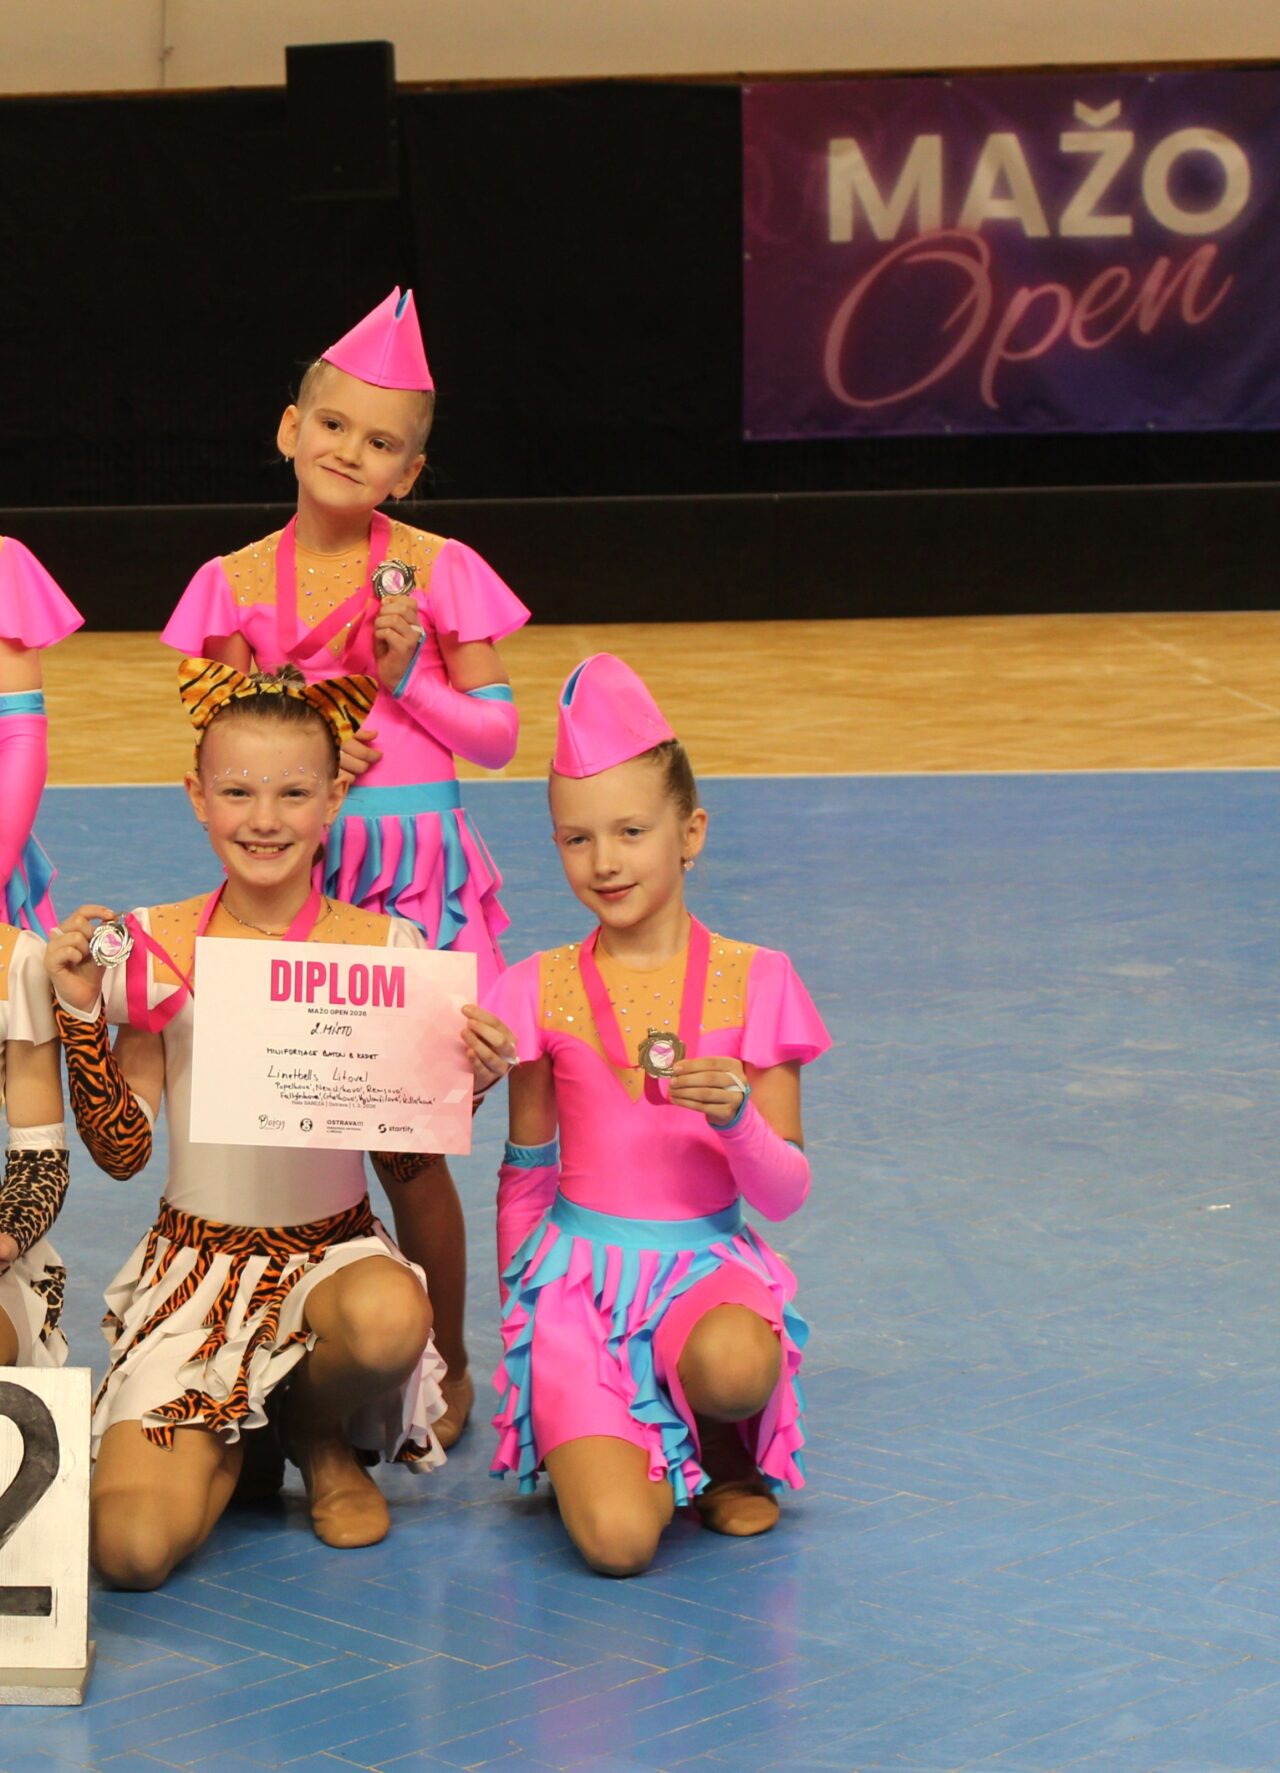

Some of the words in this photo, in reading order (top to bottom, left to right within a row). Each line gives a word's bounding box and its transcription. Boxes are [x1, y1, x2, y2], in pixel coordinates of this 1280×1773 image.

[828, 99, 1251, 243] MAŽO
[825, 228, 1234, 409] Open
[270, 959, 405, 1008] DIPLOM
[332, 1066, 369, 1083] Litovel
